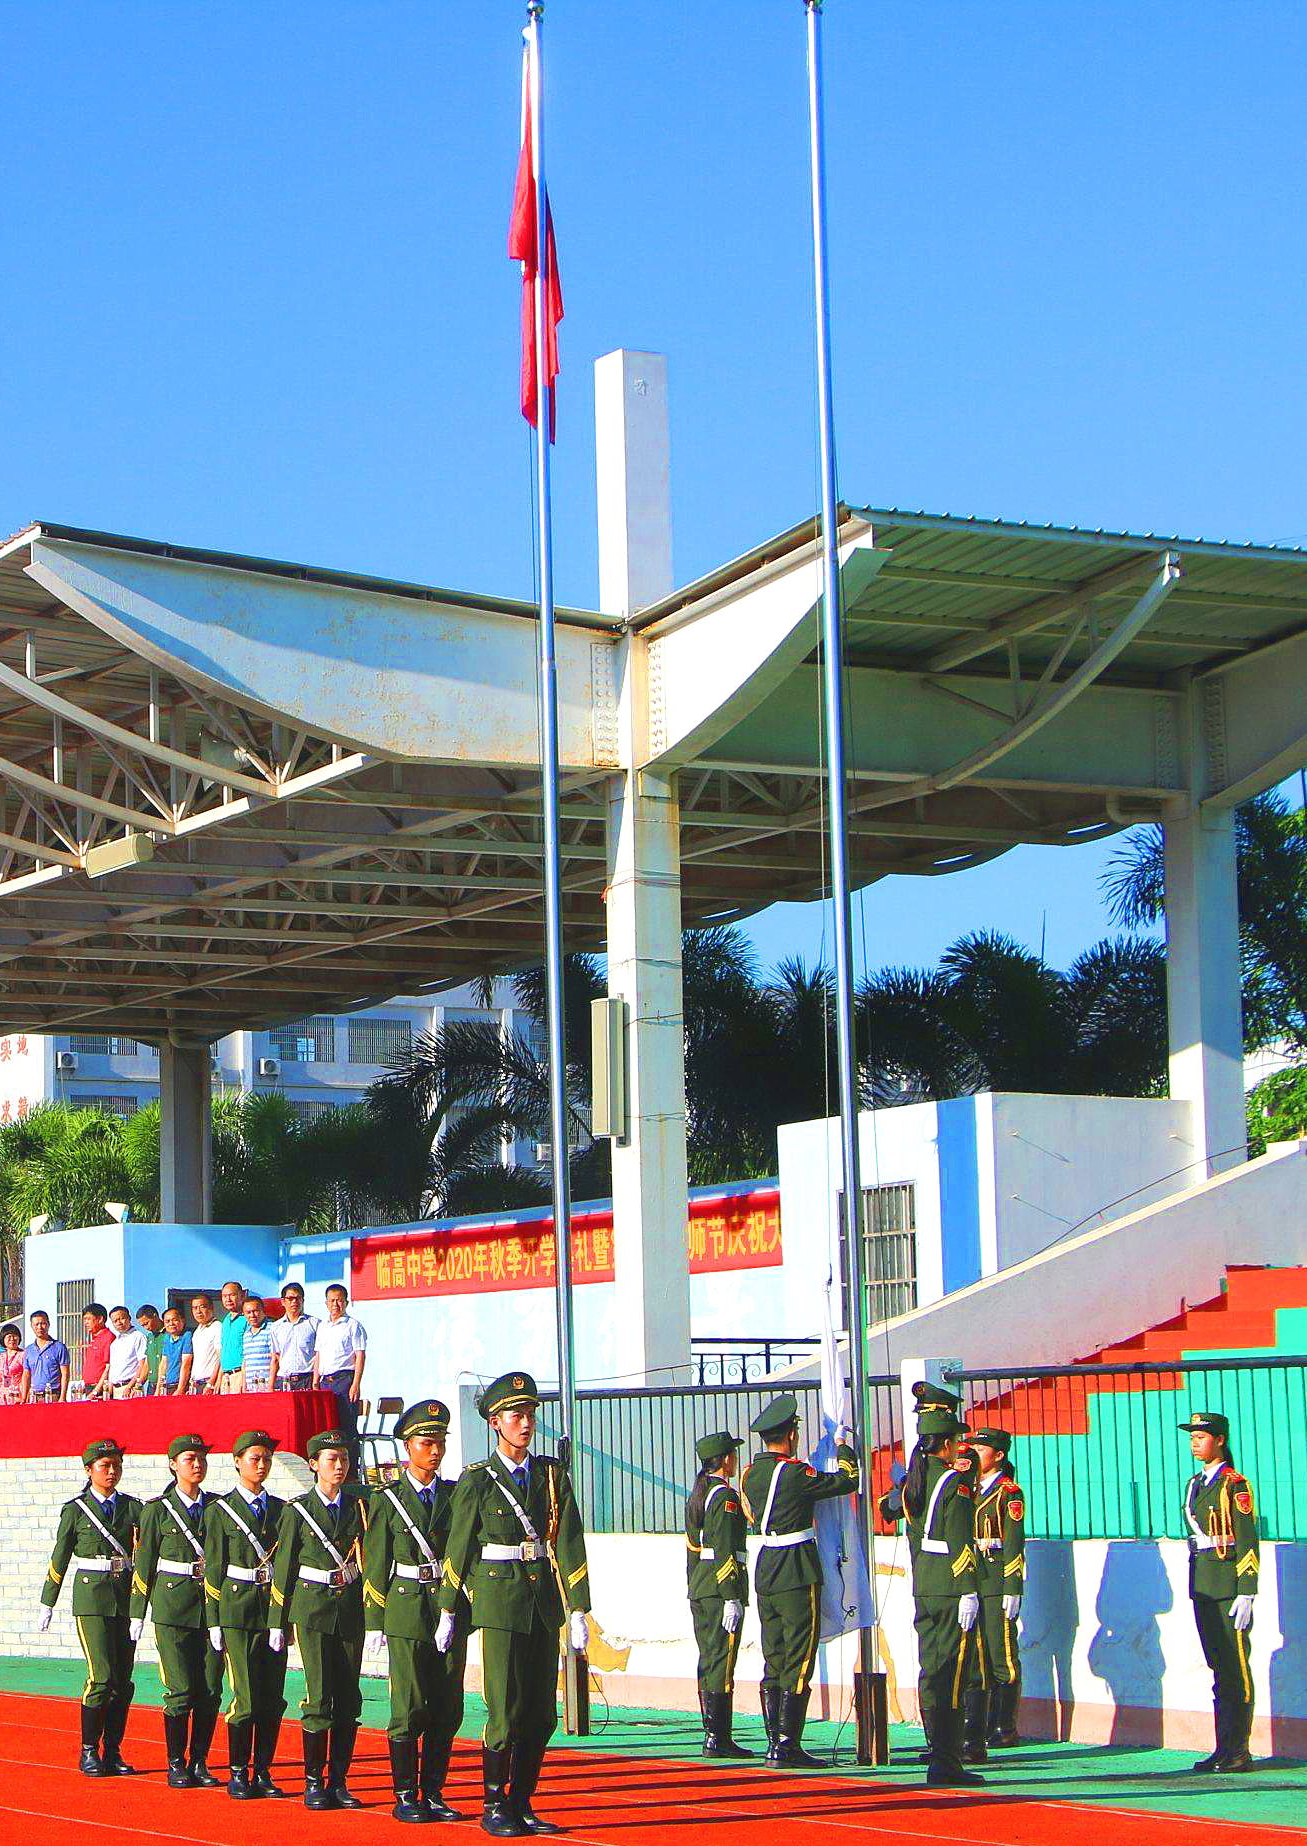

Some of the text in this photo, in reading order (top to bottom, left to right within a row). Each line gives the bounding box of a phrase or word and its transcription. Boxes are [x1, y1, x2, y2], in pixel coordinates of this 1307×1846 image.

[375, 1228, 614, 1289] 临高中学2020年秋季开学礼暨
